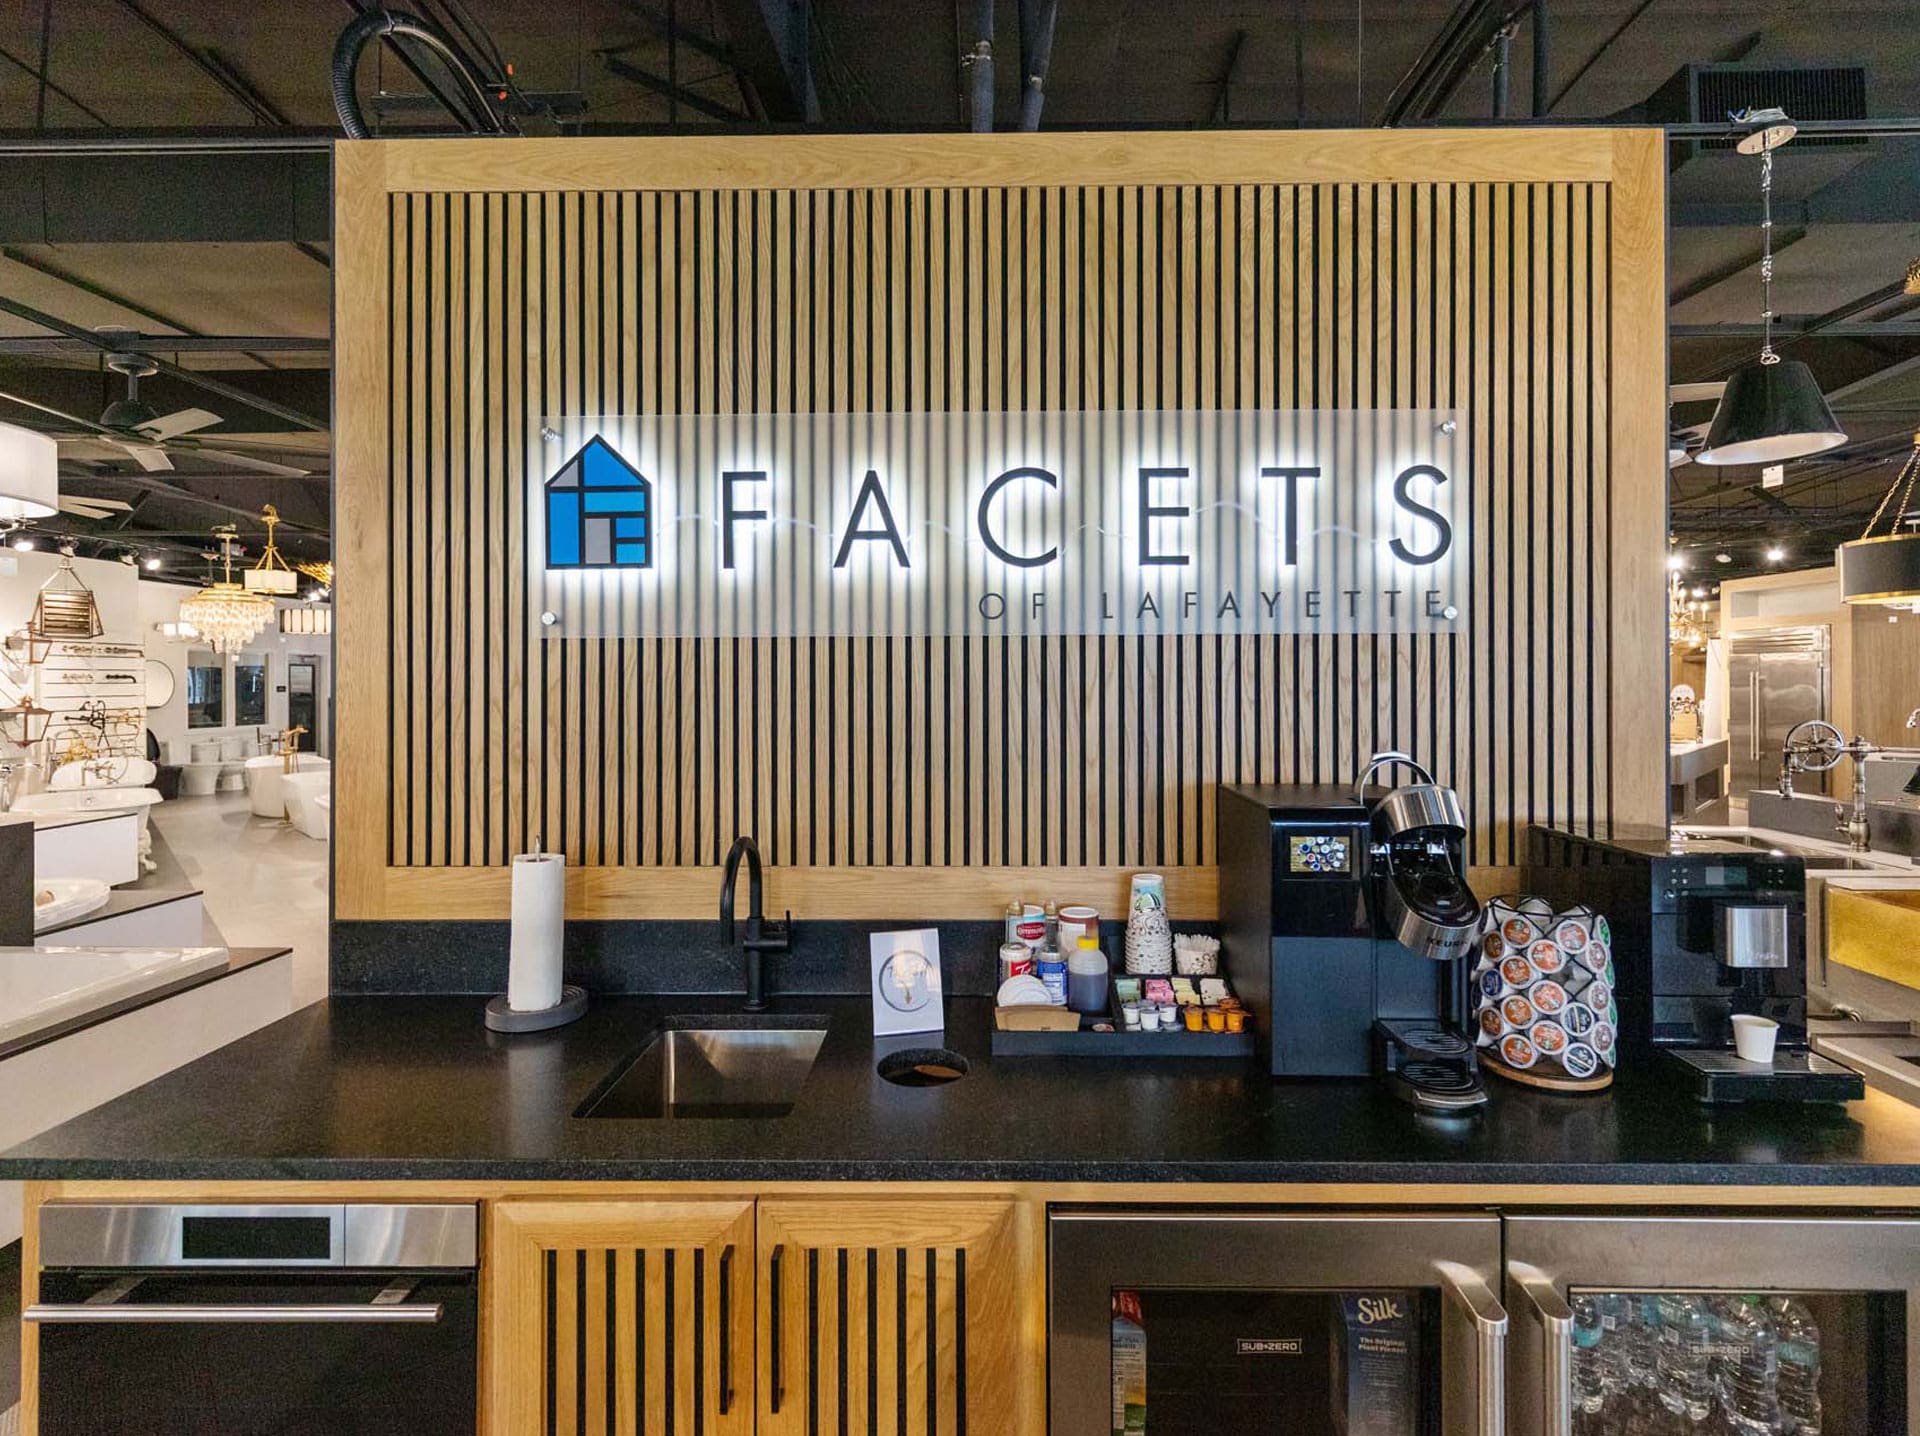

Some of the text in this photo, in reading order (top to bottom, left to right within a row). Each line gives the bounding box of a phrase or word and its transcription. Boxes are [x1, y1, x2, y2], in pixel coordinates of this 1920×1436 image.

[722, 464, 1453, 570] FACETS
[978, 590, 1441, 620] OF LAFAYETTE
[1358, 1298, 1403, 1324] Silk
